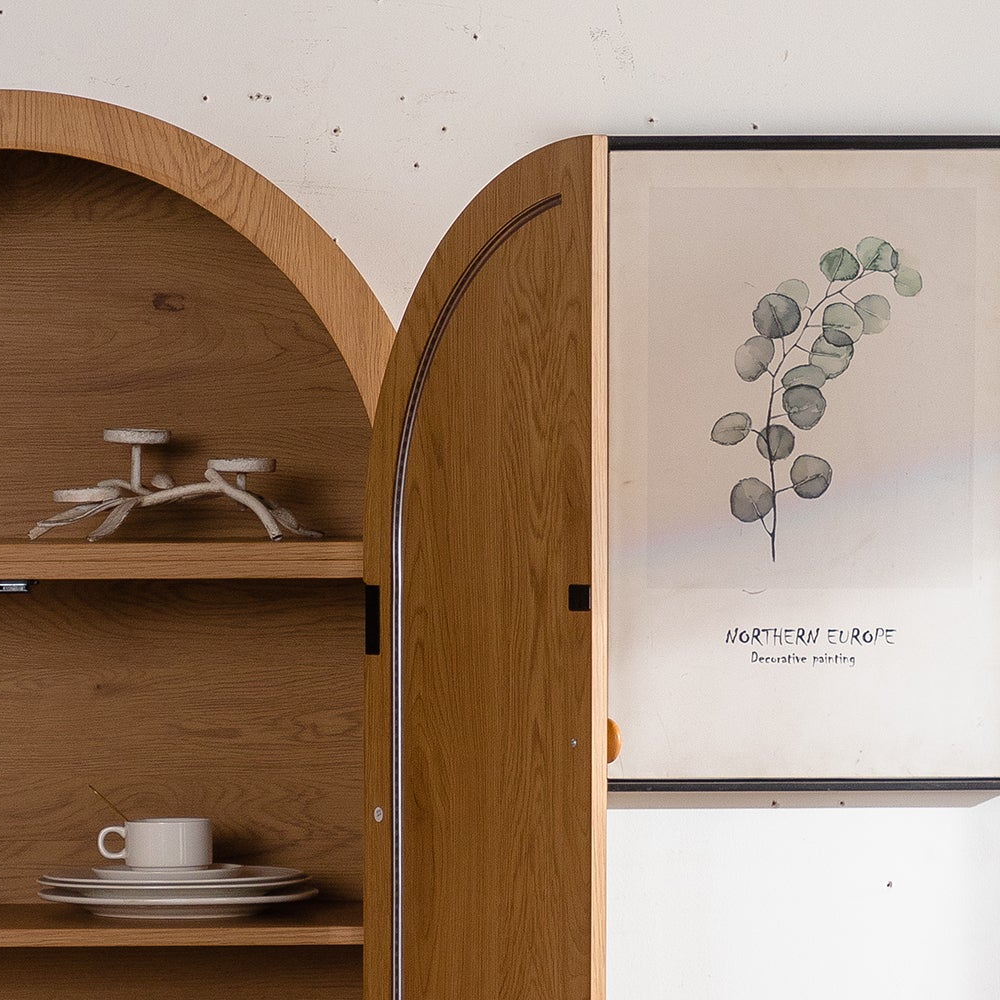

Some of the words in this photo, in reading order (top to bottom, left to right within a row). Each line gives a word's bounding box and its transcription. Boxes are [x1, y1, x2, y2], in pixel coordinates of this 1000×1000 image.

[725, 627, 820, 646] NORTHERN
[827, 626, 897, 646] EUROPE
[751, 650, 807, 664] Decorative
[812, 652, 856, 668] painting
